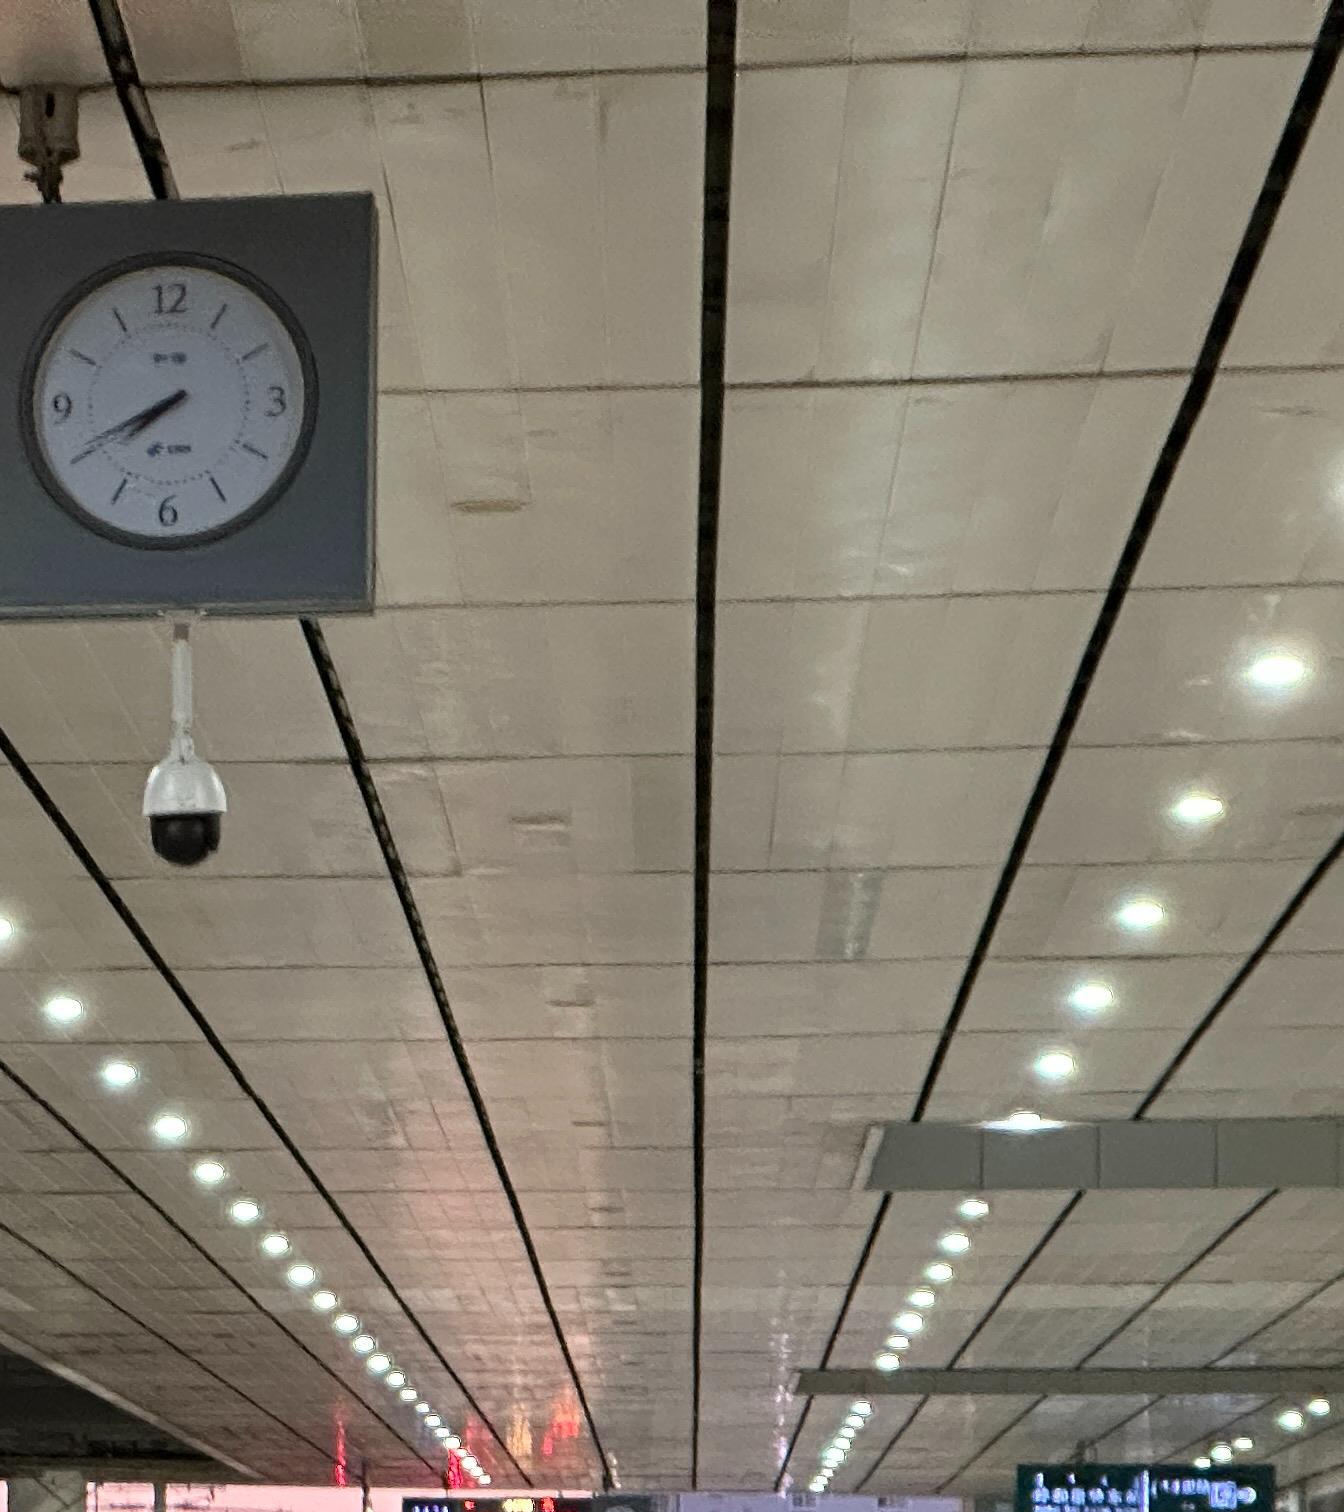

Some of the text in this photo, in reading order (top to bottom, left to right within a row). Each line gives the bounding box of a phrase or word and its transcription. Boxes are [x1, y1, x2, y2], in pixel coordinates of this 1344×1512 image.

[152, 283, 187, 314] 12
[53, 392, 72, 421] 9
[265, 385, 286, 417] 3
[158, 494, 178, 527] 6
